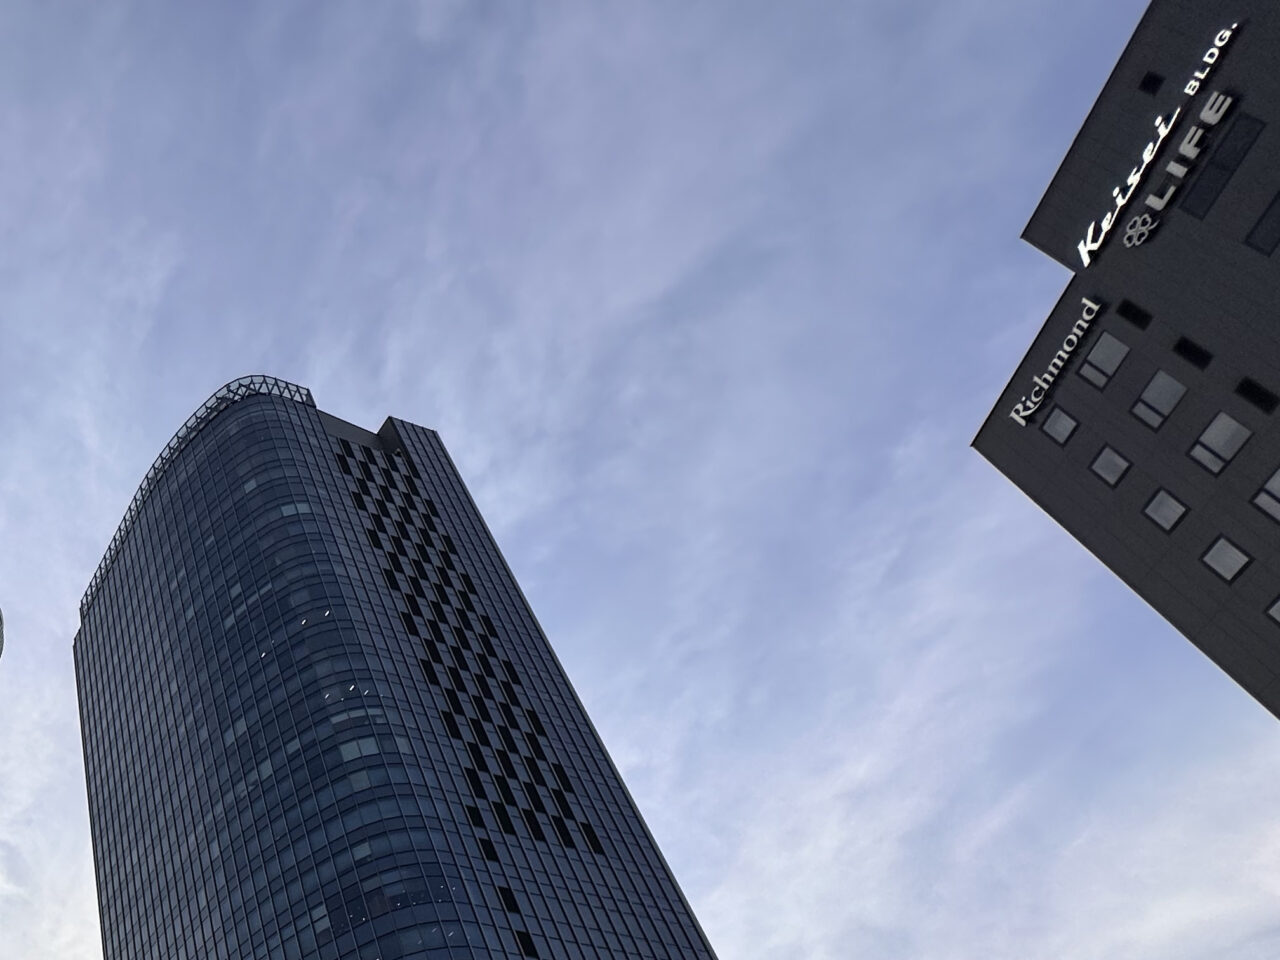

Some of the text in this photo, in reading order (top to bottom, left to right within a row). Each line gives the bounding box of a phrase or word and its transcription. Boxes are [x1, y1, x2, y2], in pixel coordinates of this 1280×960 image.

[1077, 22, 1238, 267] Keisei BLDG.
[1145, 90, 1233, 212] LIFE
[1008, 297, 1101, 427] Richmond
